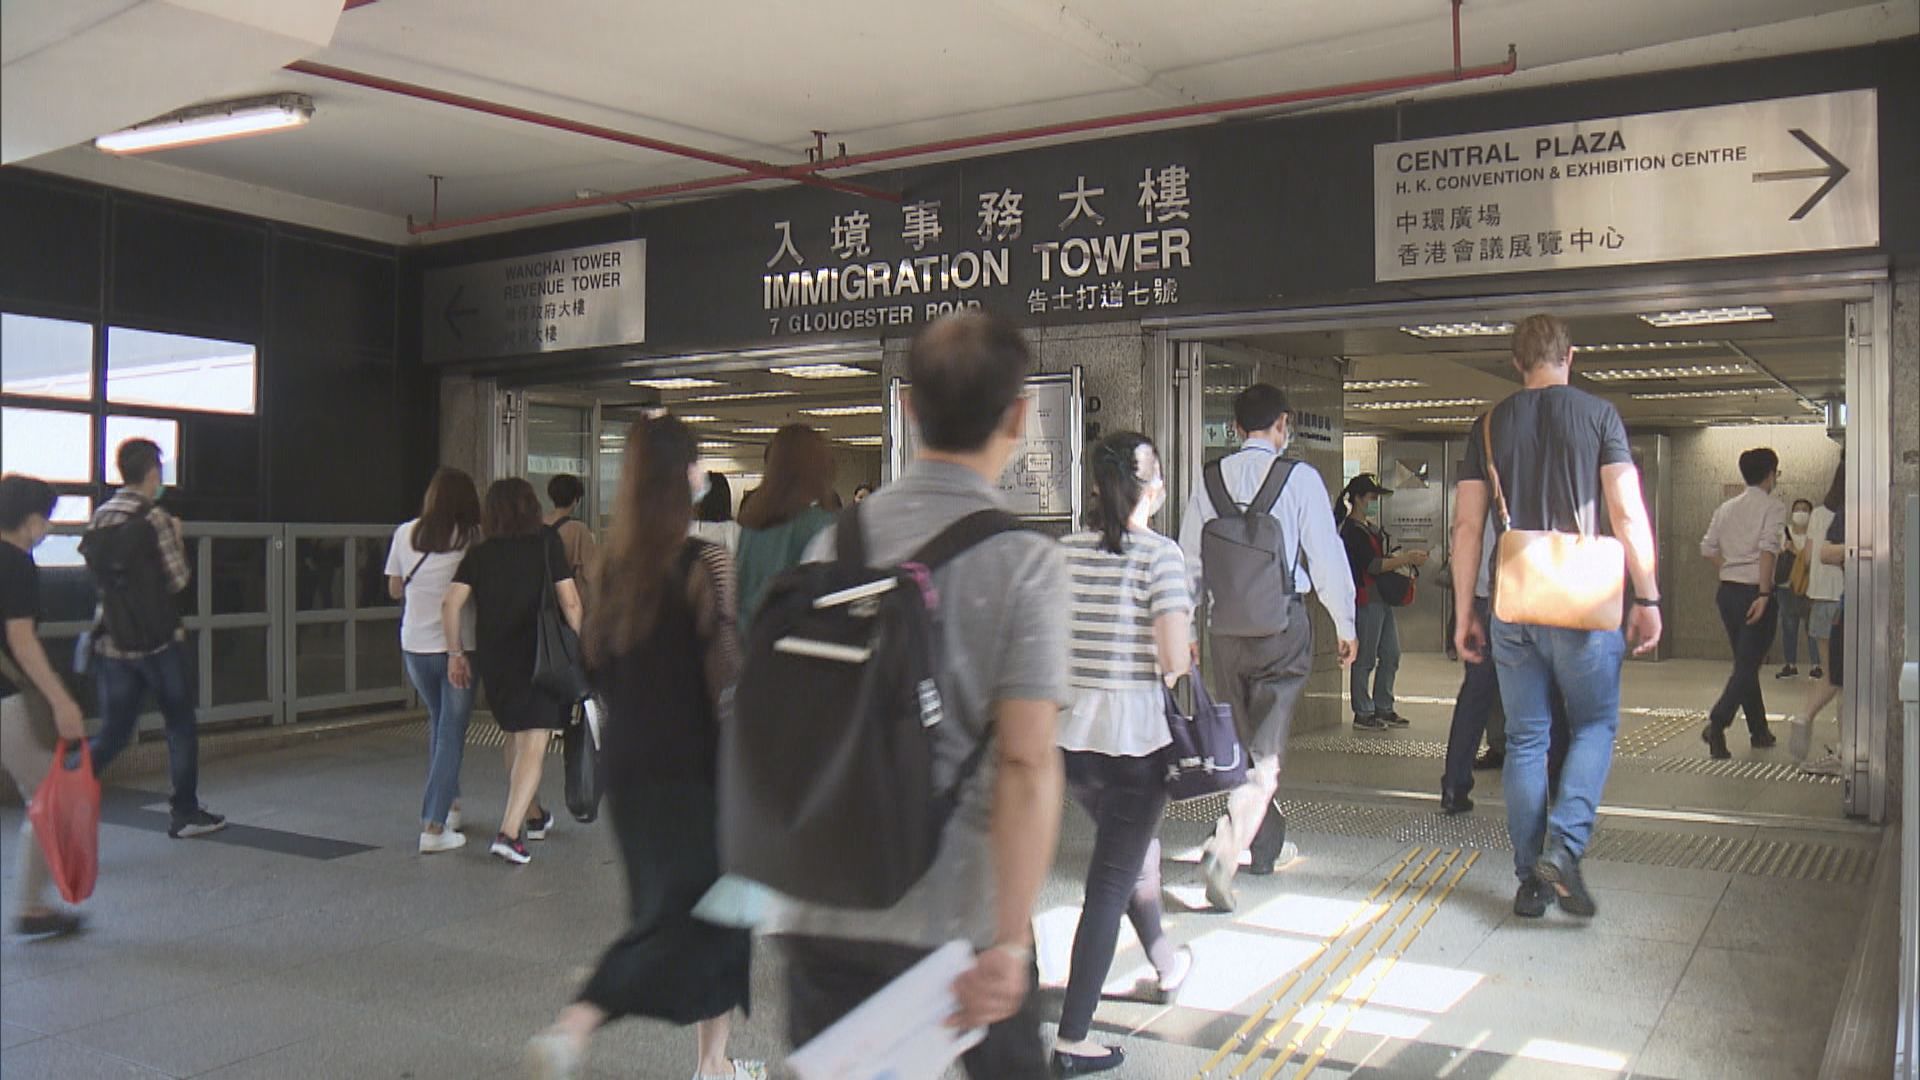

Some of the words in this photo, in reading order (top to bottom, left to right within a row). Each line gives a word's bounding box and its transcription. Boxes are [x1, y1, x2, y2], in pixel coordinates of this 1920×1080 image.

[1396, 142, 1519, 173] CENTRAL
[1535, 130, 1626, 159] PLAZA
[1396, 182, 1411, 195] H.
[1416, 180, 1431, 193] K.
[1436, 167, 1544, 191] CONVENTION
[1550, 166, 1561, 179] &
[1566, 154, 1666, 178] EXHIBITION
[1671, 146, 1748, 167] CENTRE
[765, 163, 1191, 268] 入境事務大樓
[1396, 203, 1500, 235] 中環廣場
[1398, 226, 1625, 266] 香港會議展覽中心
[505, 259, 565, 281] WANCHAI
[572, 252, 621, 272] TOWER
[763, 248, 1009, 310] IMMIGRATION
[1032, 228, 1192, 282] TOWER
[504, 279, 565, 300] REVENUE
[572, 272, 621, 292] TOWER
[1027, 278, 1178, 313] 告士打道七號
[769, 318, 780, 336] 7
[789, 305, 913, 333] GLOUCESTER
